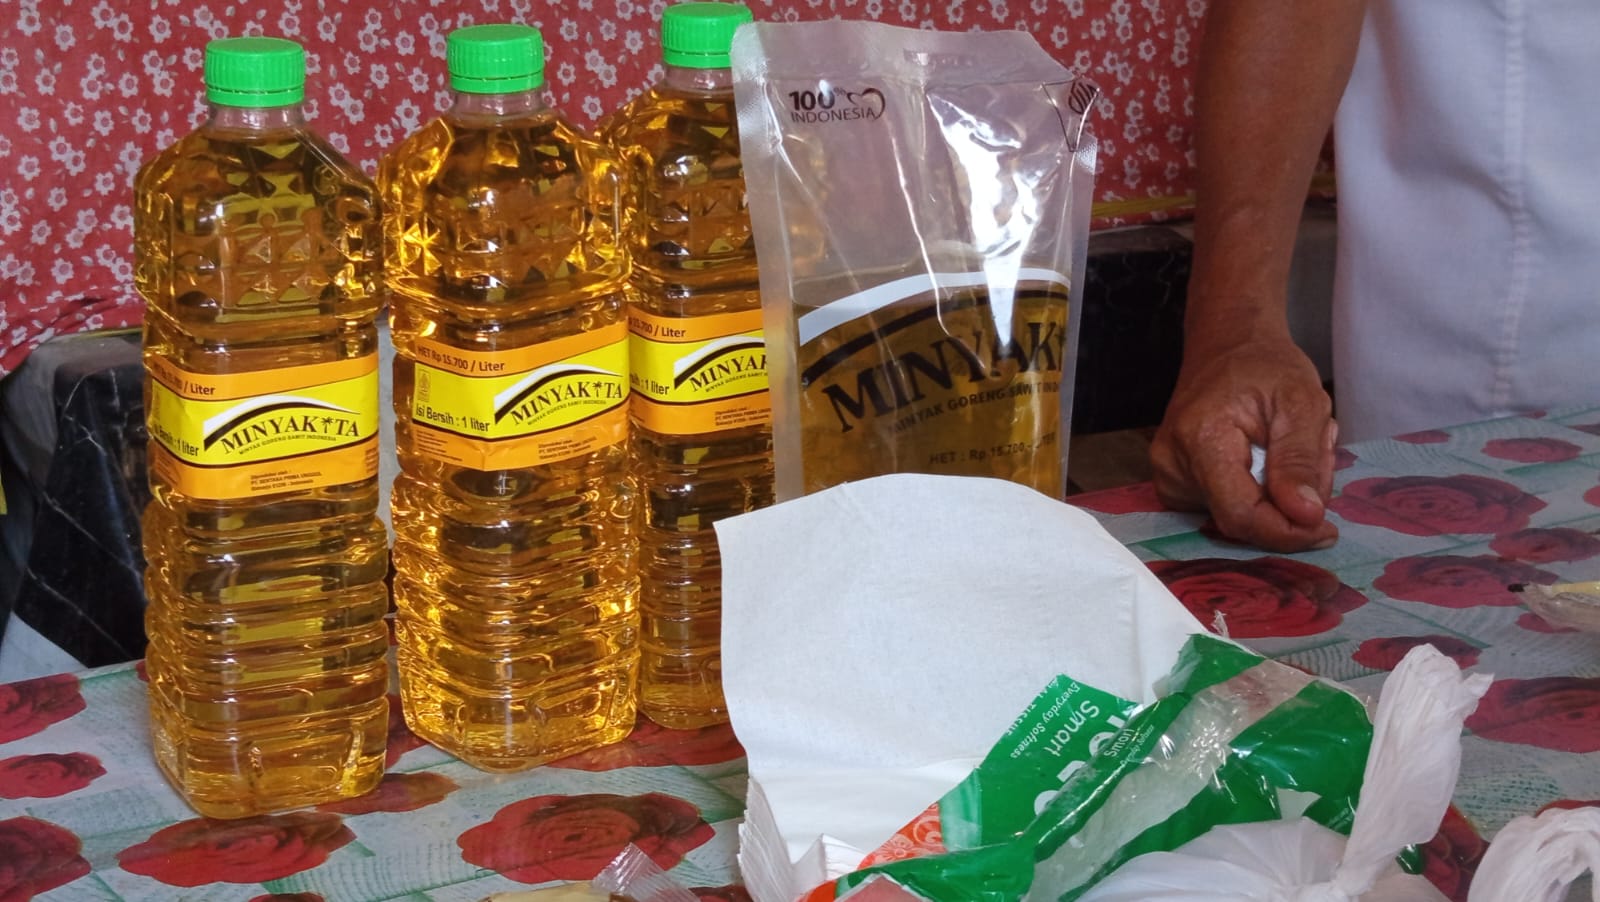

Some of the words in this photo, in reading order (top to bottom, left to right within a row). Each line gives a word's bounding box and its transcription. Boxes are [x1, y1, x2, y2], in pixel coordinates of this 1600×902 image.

[790, 106, 876, 123] INDONESIA
[661, 326, 687, 339] Liter
[442, 353, 469, 370] 15.700
[479, 361, 506, 373] Liter
[190, 382, 217, 396] Liter
[651, 379, 670, 396] liter
[947, 388, 1005, 413] GORENG
[426, 406, 455, 425] Bersih
[470, 417, 490, 432] liter
[183, 440, 200, 457] liter
[1042, 681, 1081, 724] Everyday
[1044, 700, 1100, 757] Smart
[1010, 722, 1046, 759] Softness
